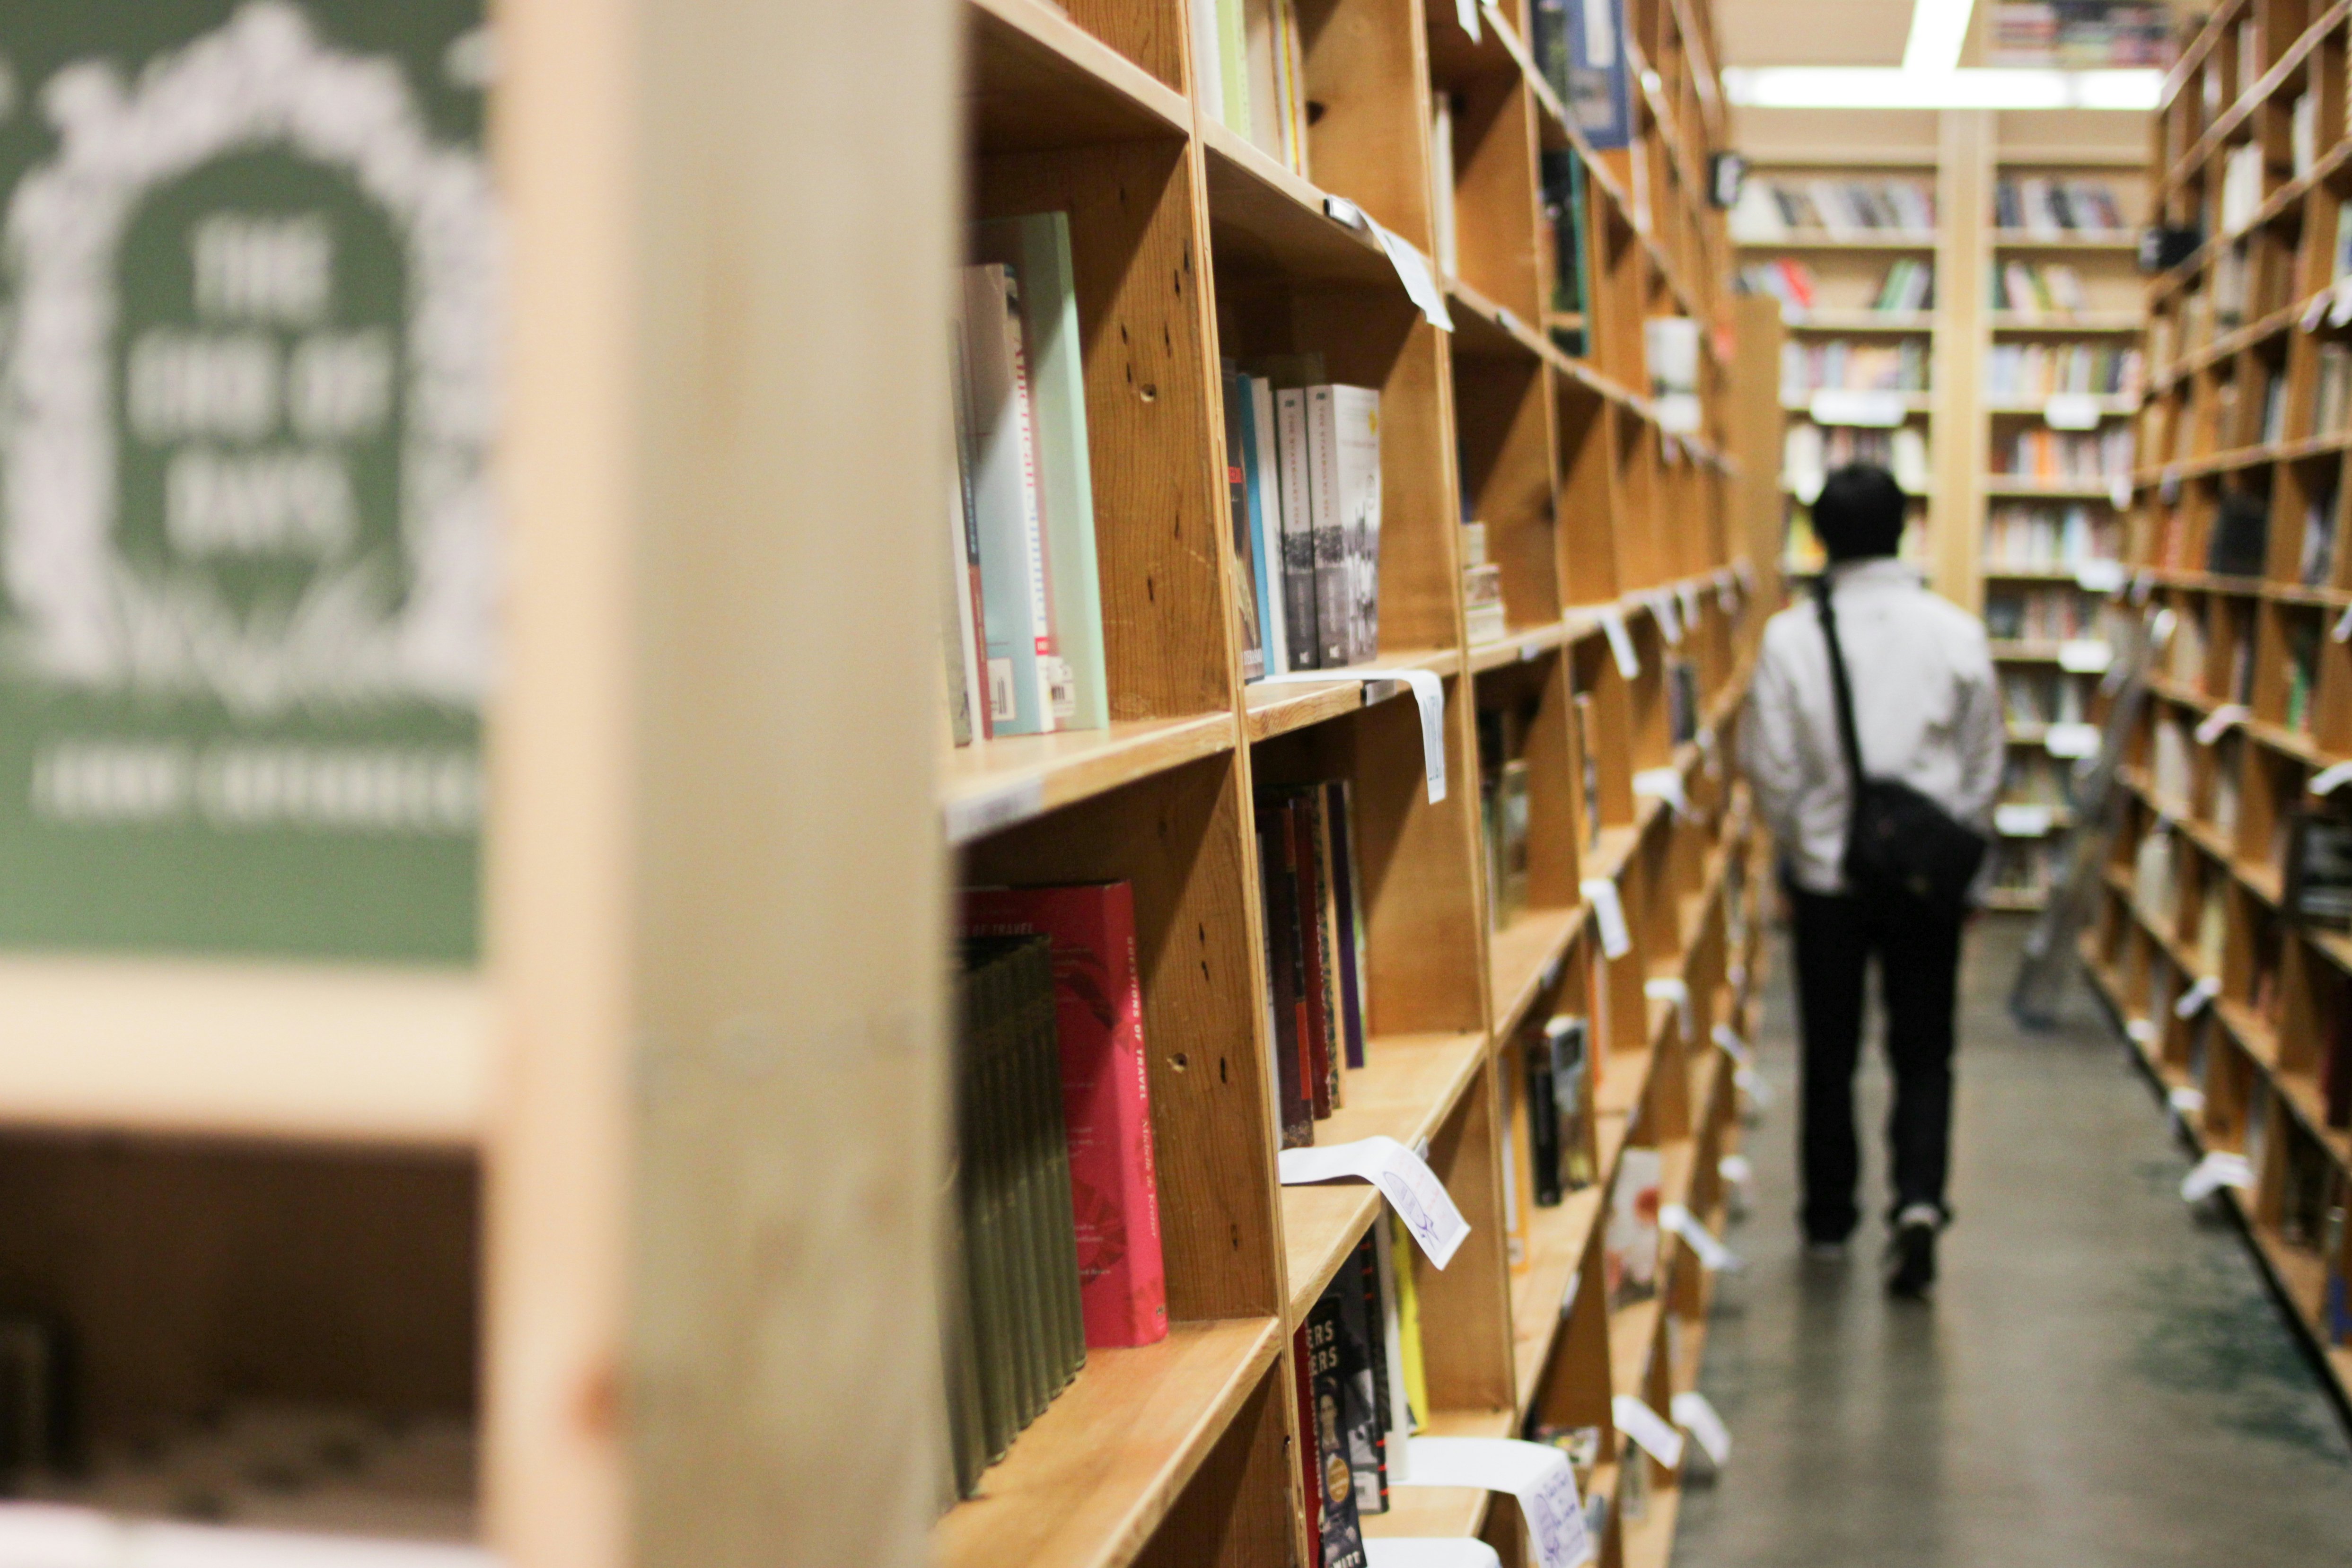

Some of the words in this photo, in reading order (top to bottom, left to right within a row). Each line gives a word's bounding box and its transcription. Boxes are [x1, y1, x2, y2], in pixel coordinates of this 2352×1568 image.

[1127, 936, 1140, 1017] QUESTIONS
[1133, 1024, 1142, 1042] OF
[1135, 1049, 1146, 1101] TRAVEL
